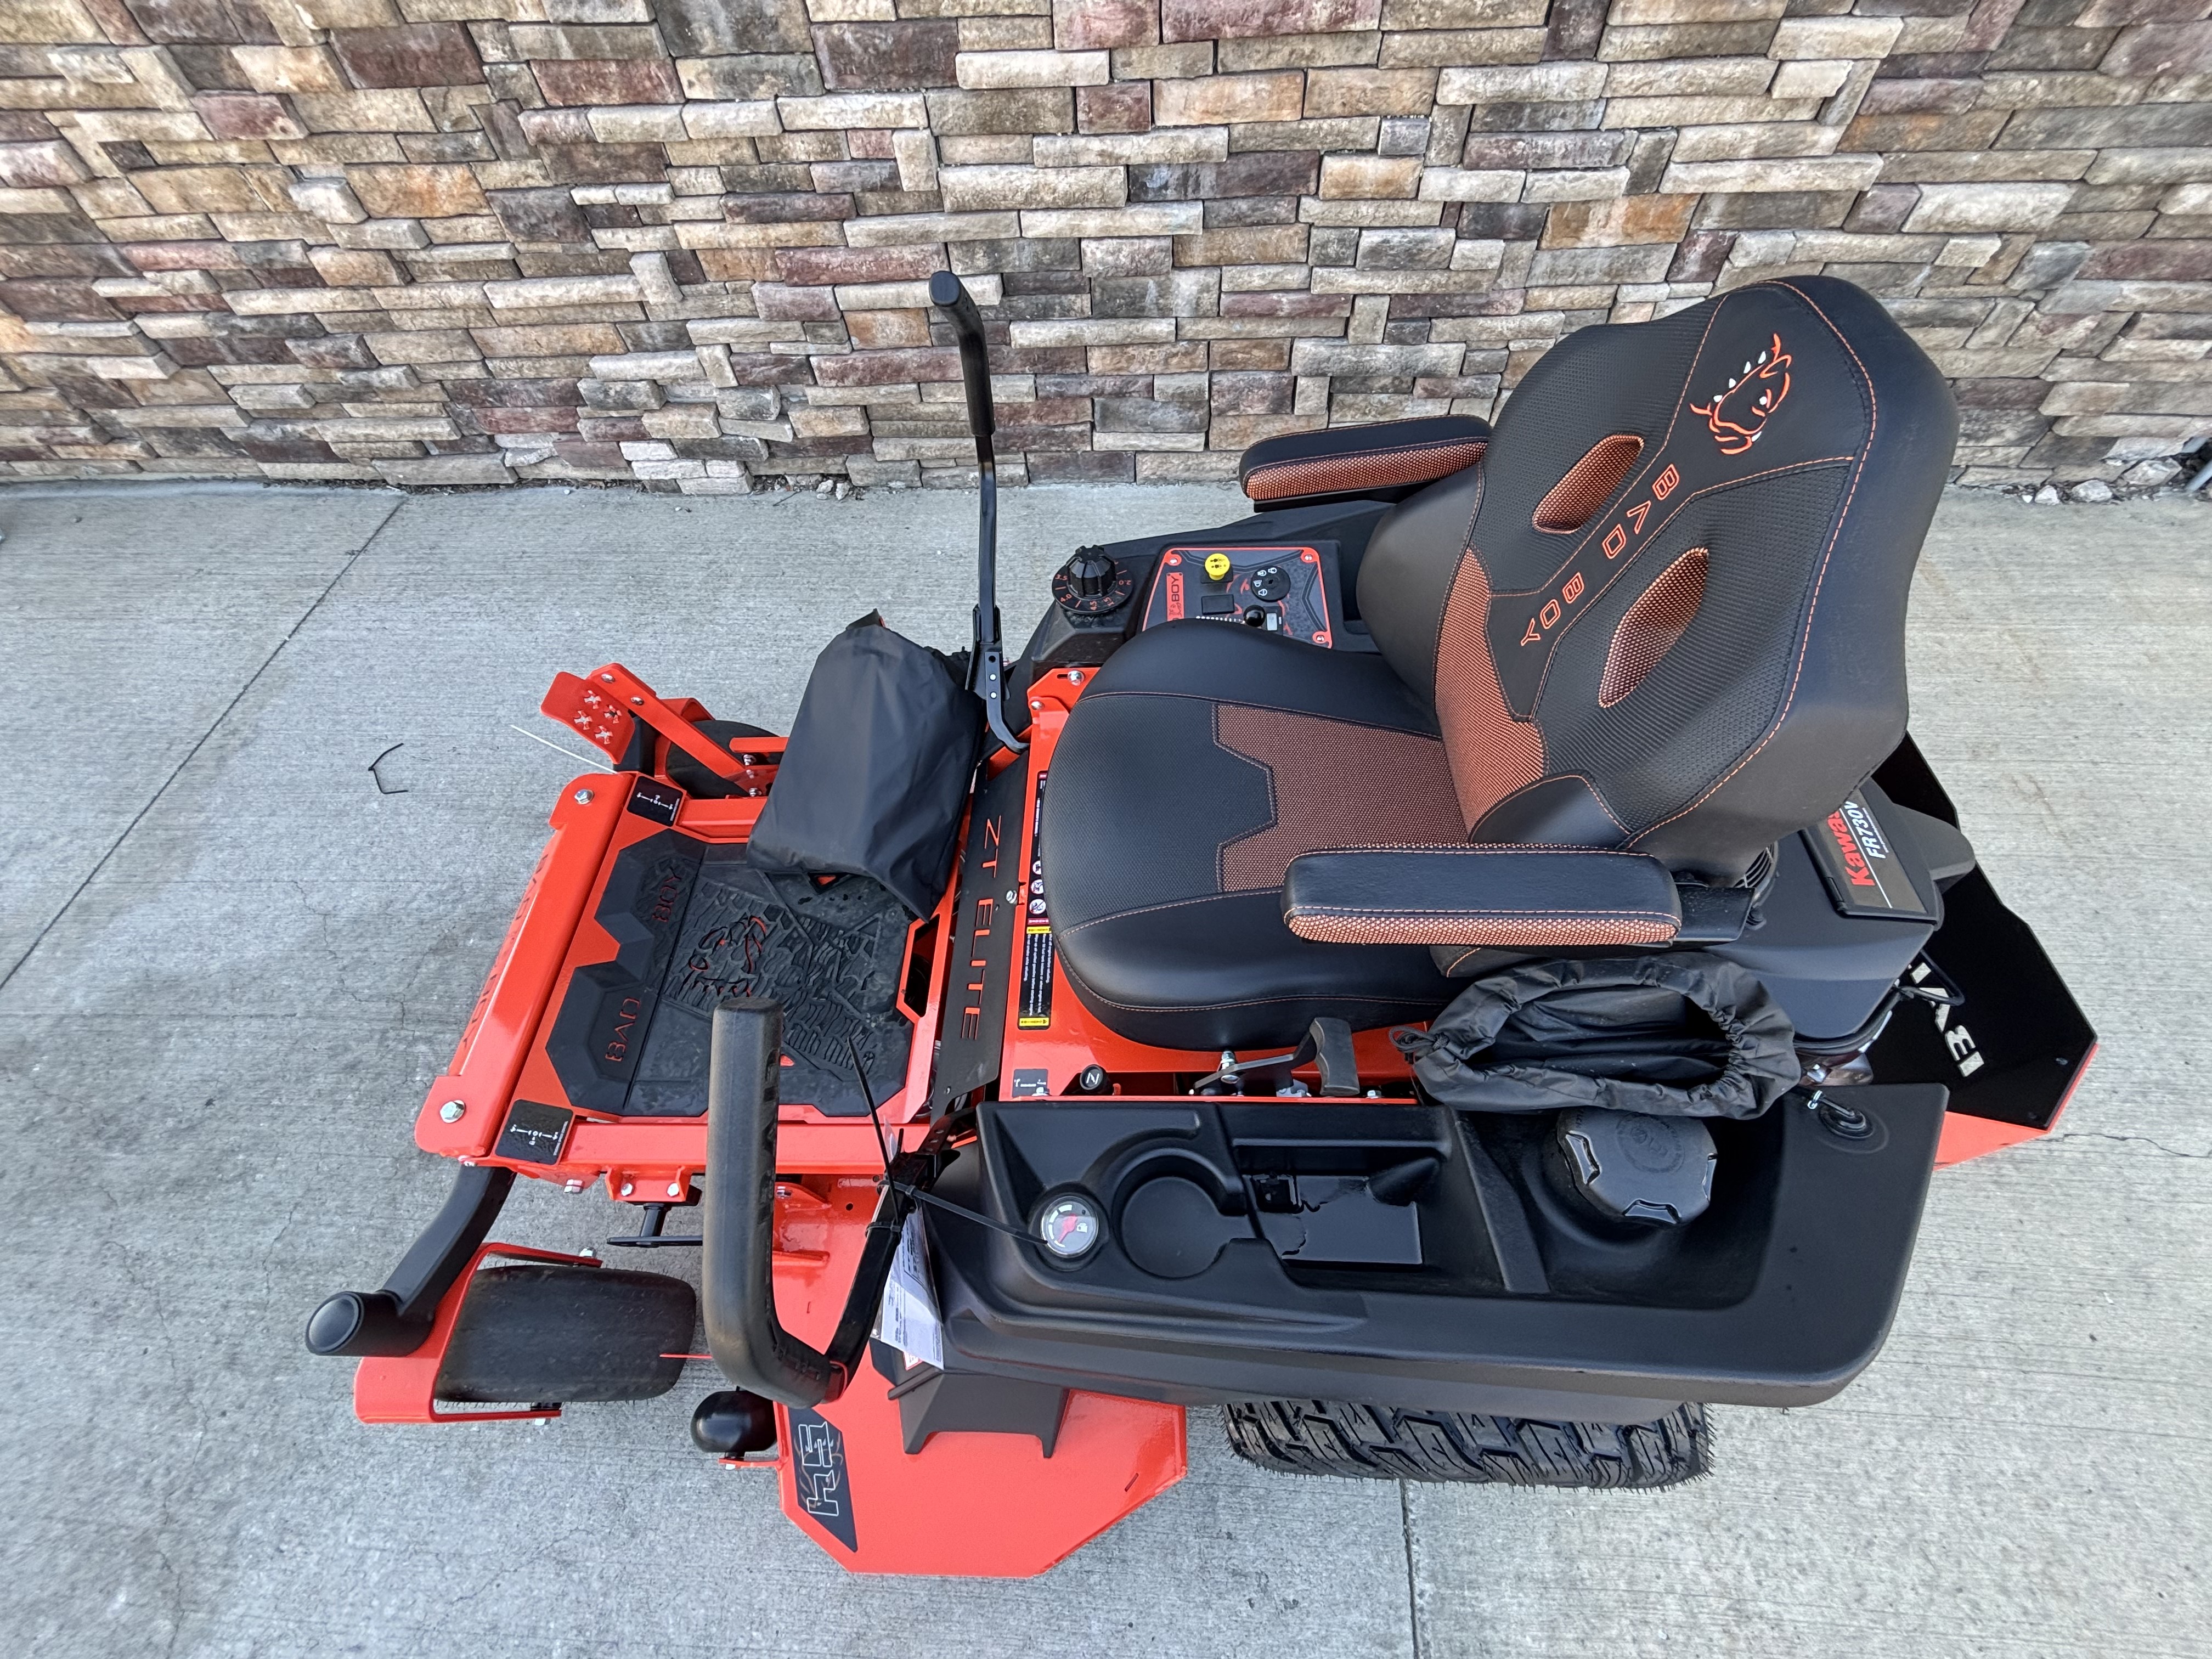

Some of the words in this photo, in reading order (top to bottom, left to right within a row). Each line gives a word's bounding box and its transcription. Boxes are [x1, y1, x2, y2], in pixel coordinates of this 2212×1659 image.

[1602, 463, 1680, 561] BAD
[1060, 594, 1073, 602] 4.0
[1089, 601, 1097, 611] 4.5
[1171, 575, 1180, 602] BOY
[1520, 572, 1585, 647] BOY
[983, 815, 1002, 878] ZT
[1827, 810, 1875, 887] Kawa
[605, 997, 641, 1063] BAD
[651, 865, 682, 923] BOY
[961, 898, 994, 1040] ELITE
[1086, 1072, 1100, 1085] N
[798, 1420, 840, 1517] 54
